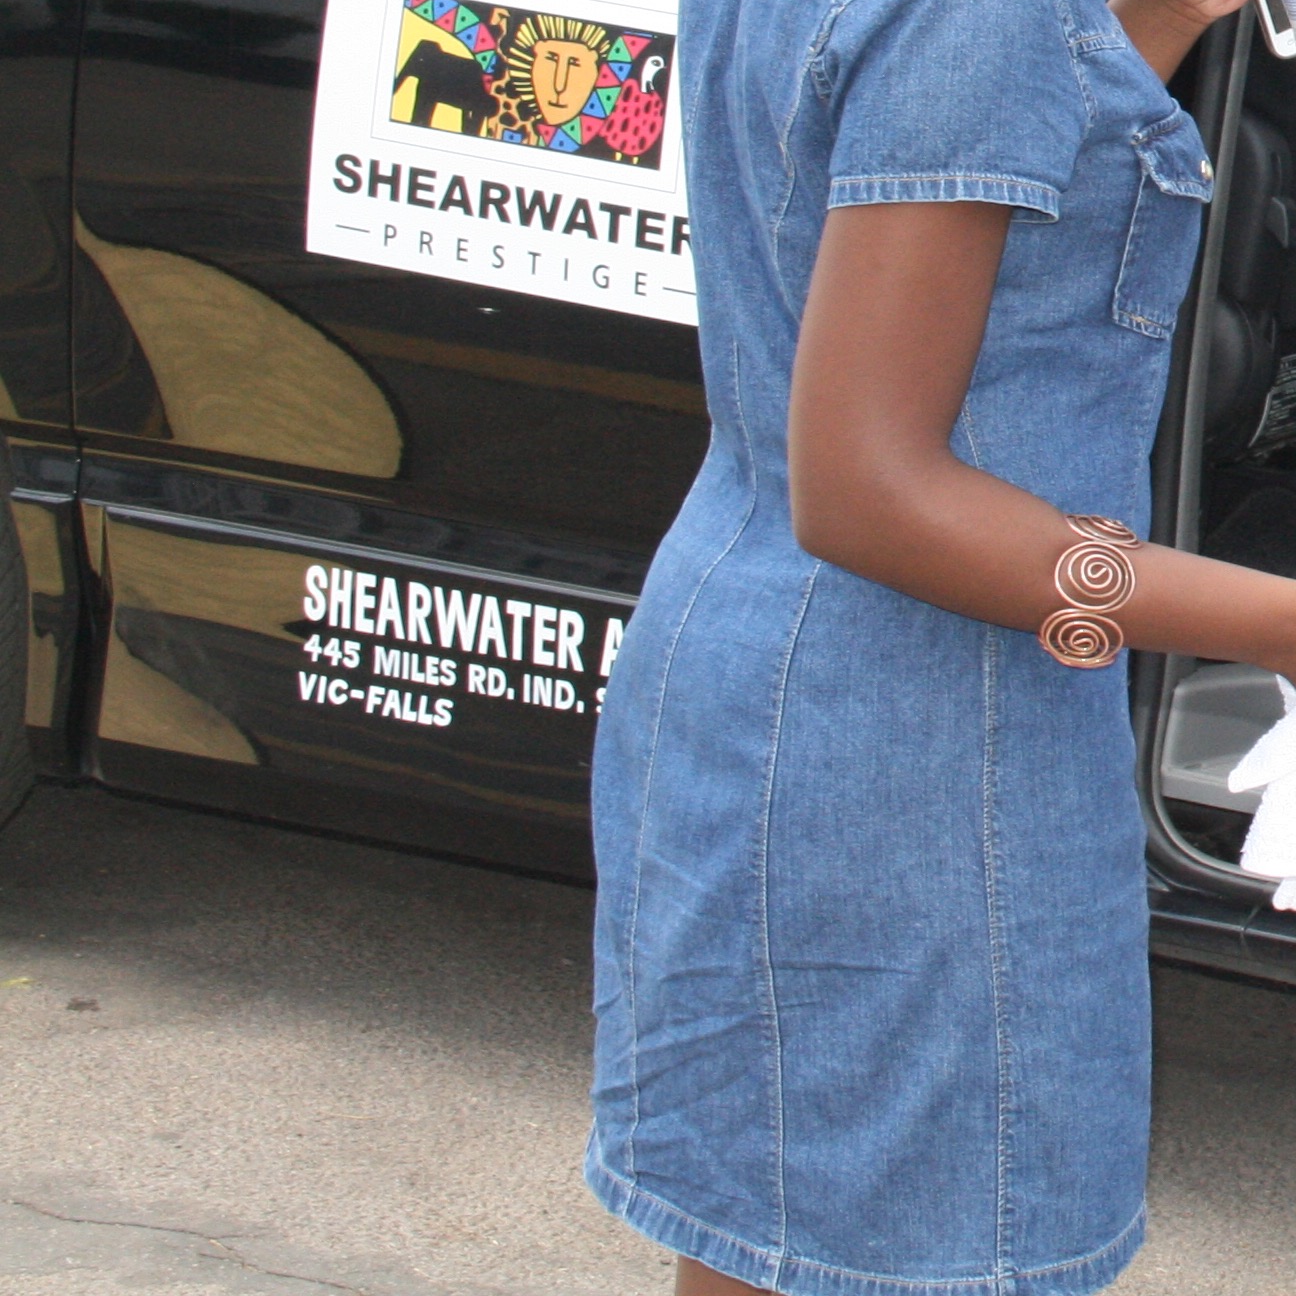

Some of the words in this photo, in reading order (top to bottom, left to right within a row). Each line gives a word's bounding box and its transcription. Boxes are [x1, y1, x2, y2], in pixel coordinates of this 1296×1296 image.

[383, 224, 648, 297] PRESTIGE
[304, 565, 585, 672] SHEARWATER
[298, 671, 454, 727] VIC-FALLS
[304, 634, 361, 669] 445
[373, 645, 458, 686] MILES
[466, 663, 515, 701] RD.
[522, 673, 584, 714] IND.
